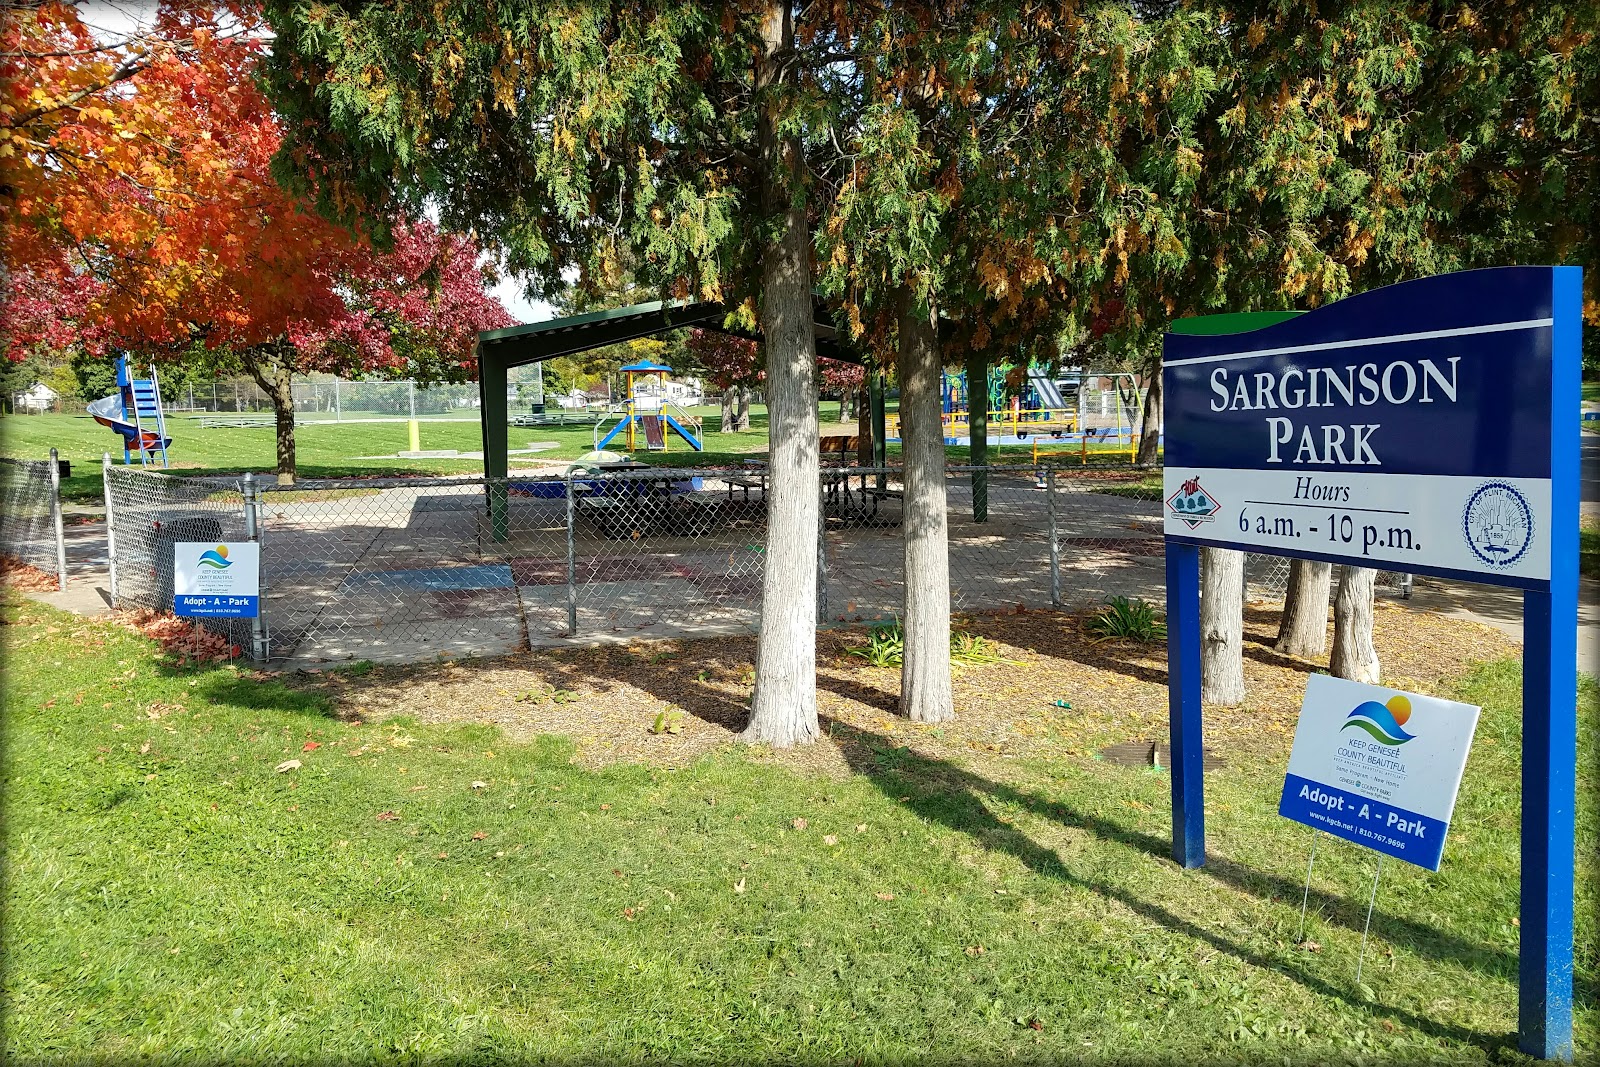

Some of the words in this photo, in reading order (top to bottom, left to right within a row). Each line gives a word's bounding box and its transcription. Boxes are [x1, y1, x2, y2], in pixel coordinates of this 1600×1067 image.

[1209, 356, 1461, 412] SARGINSON
[1265, 417, 1382, 466] PARK
[1293, 476, 1350, 502] Hours
[1469, 505, 1477, 524] CITY
[1475, 496, 1483, 506] OF
[1505, 492, 1527, 529] MICHIGAN
[1239, 507, 1249, 533] 6
[1256, 515, 1301, 538] a.m.
[1327, 514, 1353, 543] 10
[1362, 523, 1422, 556] p.m.
[184, 597, 206, 606] Adopt
[214, 597, 220, 605] A
[228, 598, 249, 606] Park
[1337, 747, 1366, 761] COUNTY
[1367, 755, 1406, 773] BEAUTIFUL
[1348, 738, 1367, 749] KEEP
[1367, 744, 1401, 759] GENESEE
[1335, 765, 1349, 774] Same
[1349, 769, 1369, 780] Program
[1373, 776, 1385, 784] New
[1385, 779, 1400, 789] Home
[1299, 784, 1345, 811] Adopt
[1358, 803, 1370, 820] A
[1386, 811, 1427, 838] Park
[1309, 810, 1354, 832] www.kgcb.net
[1358, 827, 1406, 850] 810.767.9696
